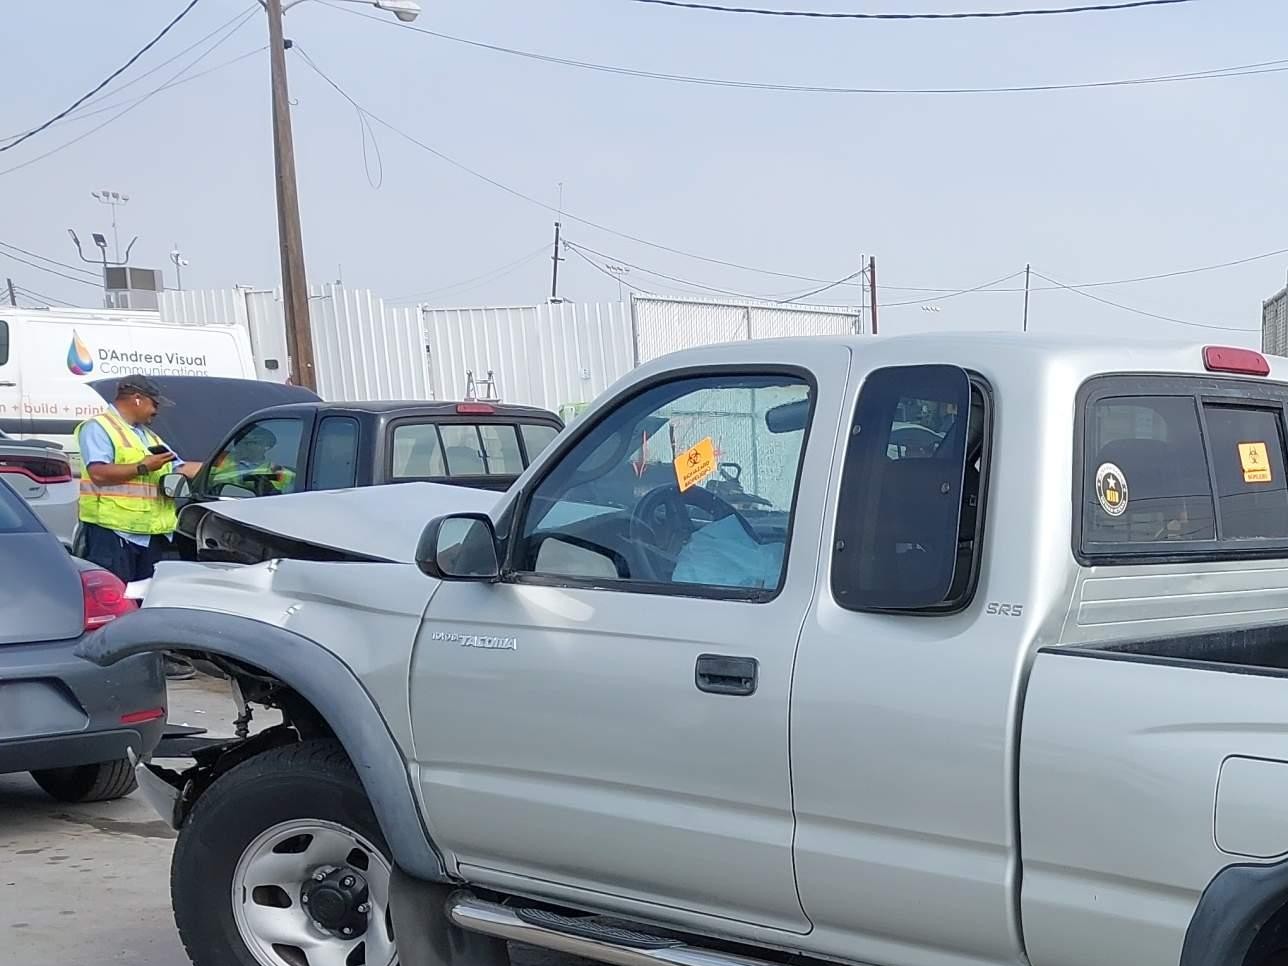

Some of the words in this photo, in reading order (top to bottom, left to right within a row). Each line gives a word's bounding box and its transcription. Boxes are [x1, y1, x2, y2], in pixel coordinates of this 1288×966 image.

[98, 348, 163, 363] D'Andrea
[166, 352, 206, 366] Visual
[99, 362, 209, 377] Communications
[23, 402, 57, 414] build
[75, 404, 104, 416] print
[986, 602, 1023, 617] SRS
